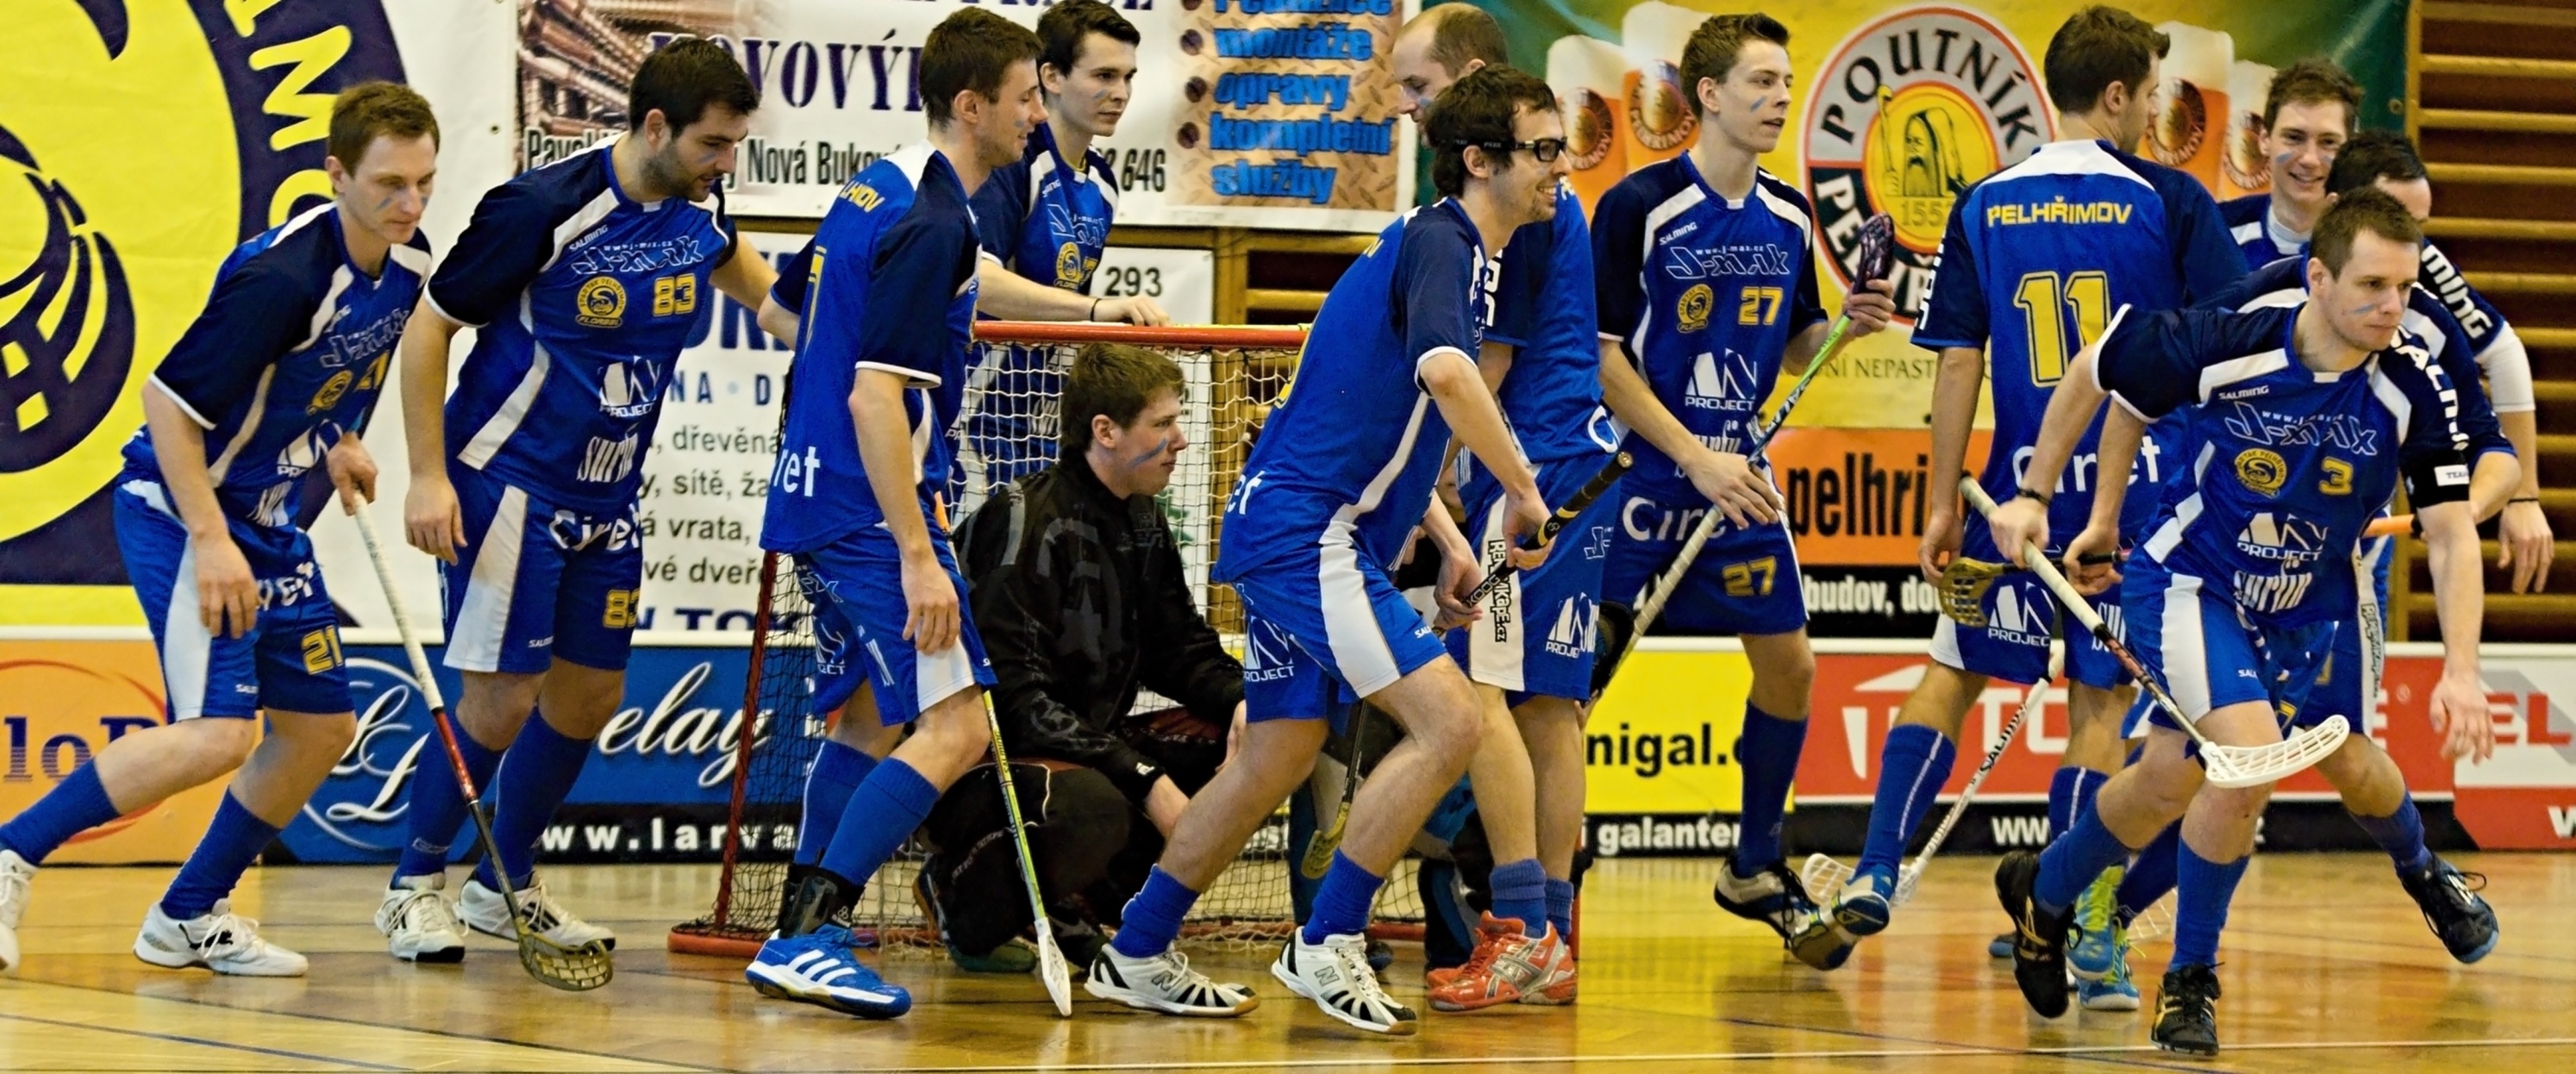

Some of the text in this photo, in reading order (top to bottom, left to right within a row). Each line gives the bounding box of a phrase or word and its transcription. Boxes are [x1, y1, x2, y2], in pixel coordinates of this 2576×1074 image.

[1214, 72, 1351, 111] opravy
[1819, 28, 2041, 151] POUTNÍK
[1210, 112, 1397, 157] kompletní
[747, 138, 806, 184] Nová
[1122, 149, 1166, 192] 646
[1210, 159, 1337, 204] služby
[1901, 199, 1952, 227] 155
[1986, 195, 2133, 228] PELHŘIMOV
[569, 224, 609, 252] SALMING
[1659, 222, 1698, 246] SALMING
[653, 273, 696, 316] 83
[1104, 267, 1162, 297] 293
[1738, 286, 1784, 326] 27
[2013, 270, 2112, 388] 11
[1854, 359, 1937, 378] NEPAST
[1685, 397, 1755, 411] PROJECT
[2218, 385, 2269, 400] SALMING
[673, 468, 731, 501] sítě,
[2318, 456, 2354, 495] 3
[1788, 453, 1928, 540] pelhri
[668, 515, 750, 546] vrata,
[643, 554, 677, 582] vé
[2237, 542, 2323, 561] PROJECT
[1722, 555, 1778, 596] 27
[301, 625, 344, 676] 21
[1987, 628, 2052, 648] PROJEC
[597, 661, 774, 789] elay
